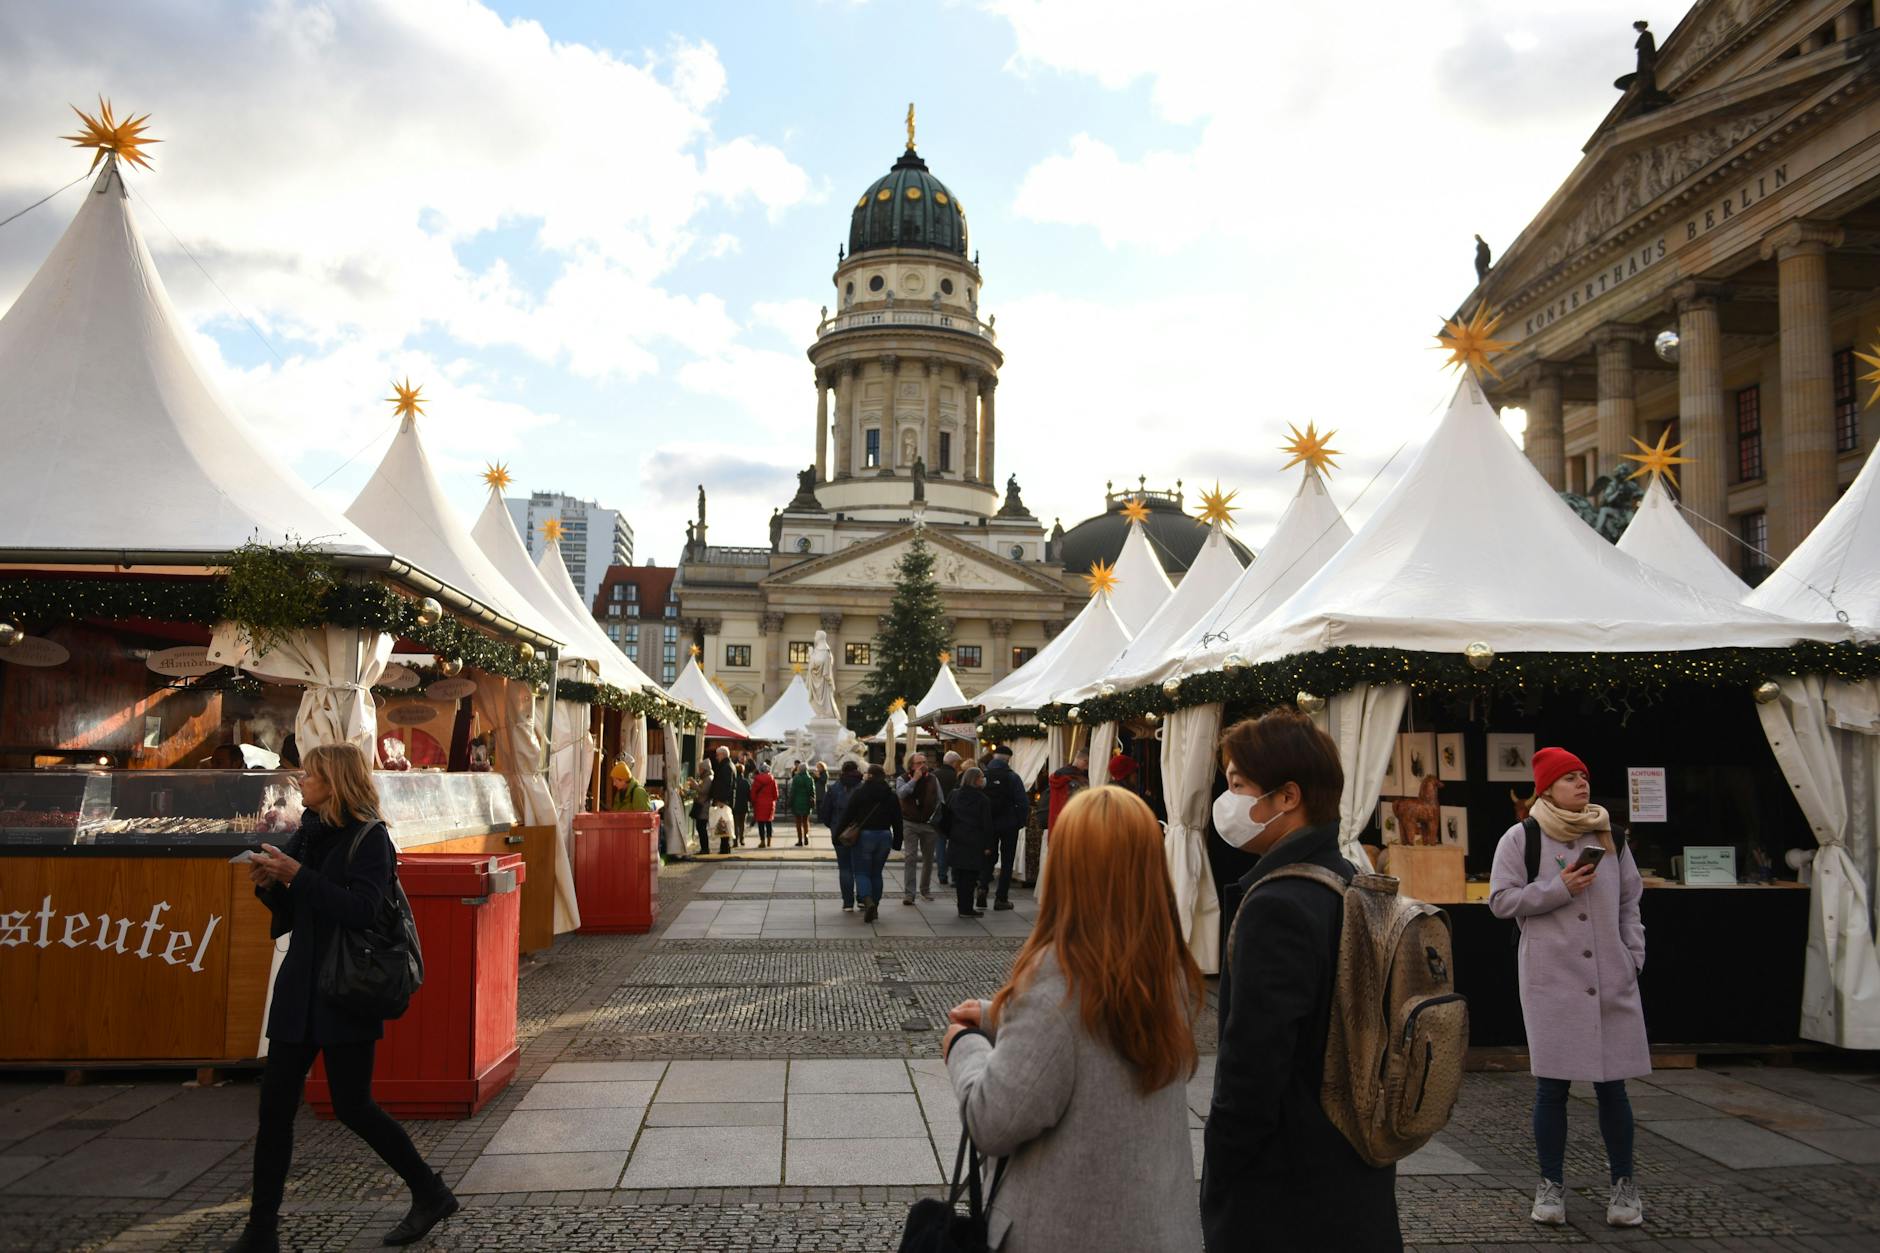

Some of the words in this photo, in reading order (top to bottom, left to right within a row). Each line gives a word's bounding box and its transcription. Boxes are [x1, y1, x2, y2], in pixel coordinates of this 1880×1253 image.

[1525, 239, 1667, 335] KONZERTHAUS
[1687, 164, 1787, 241] BERLIN
[0, 894, 223, 972] steufel
